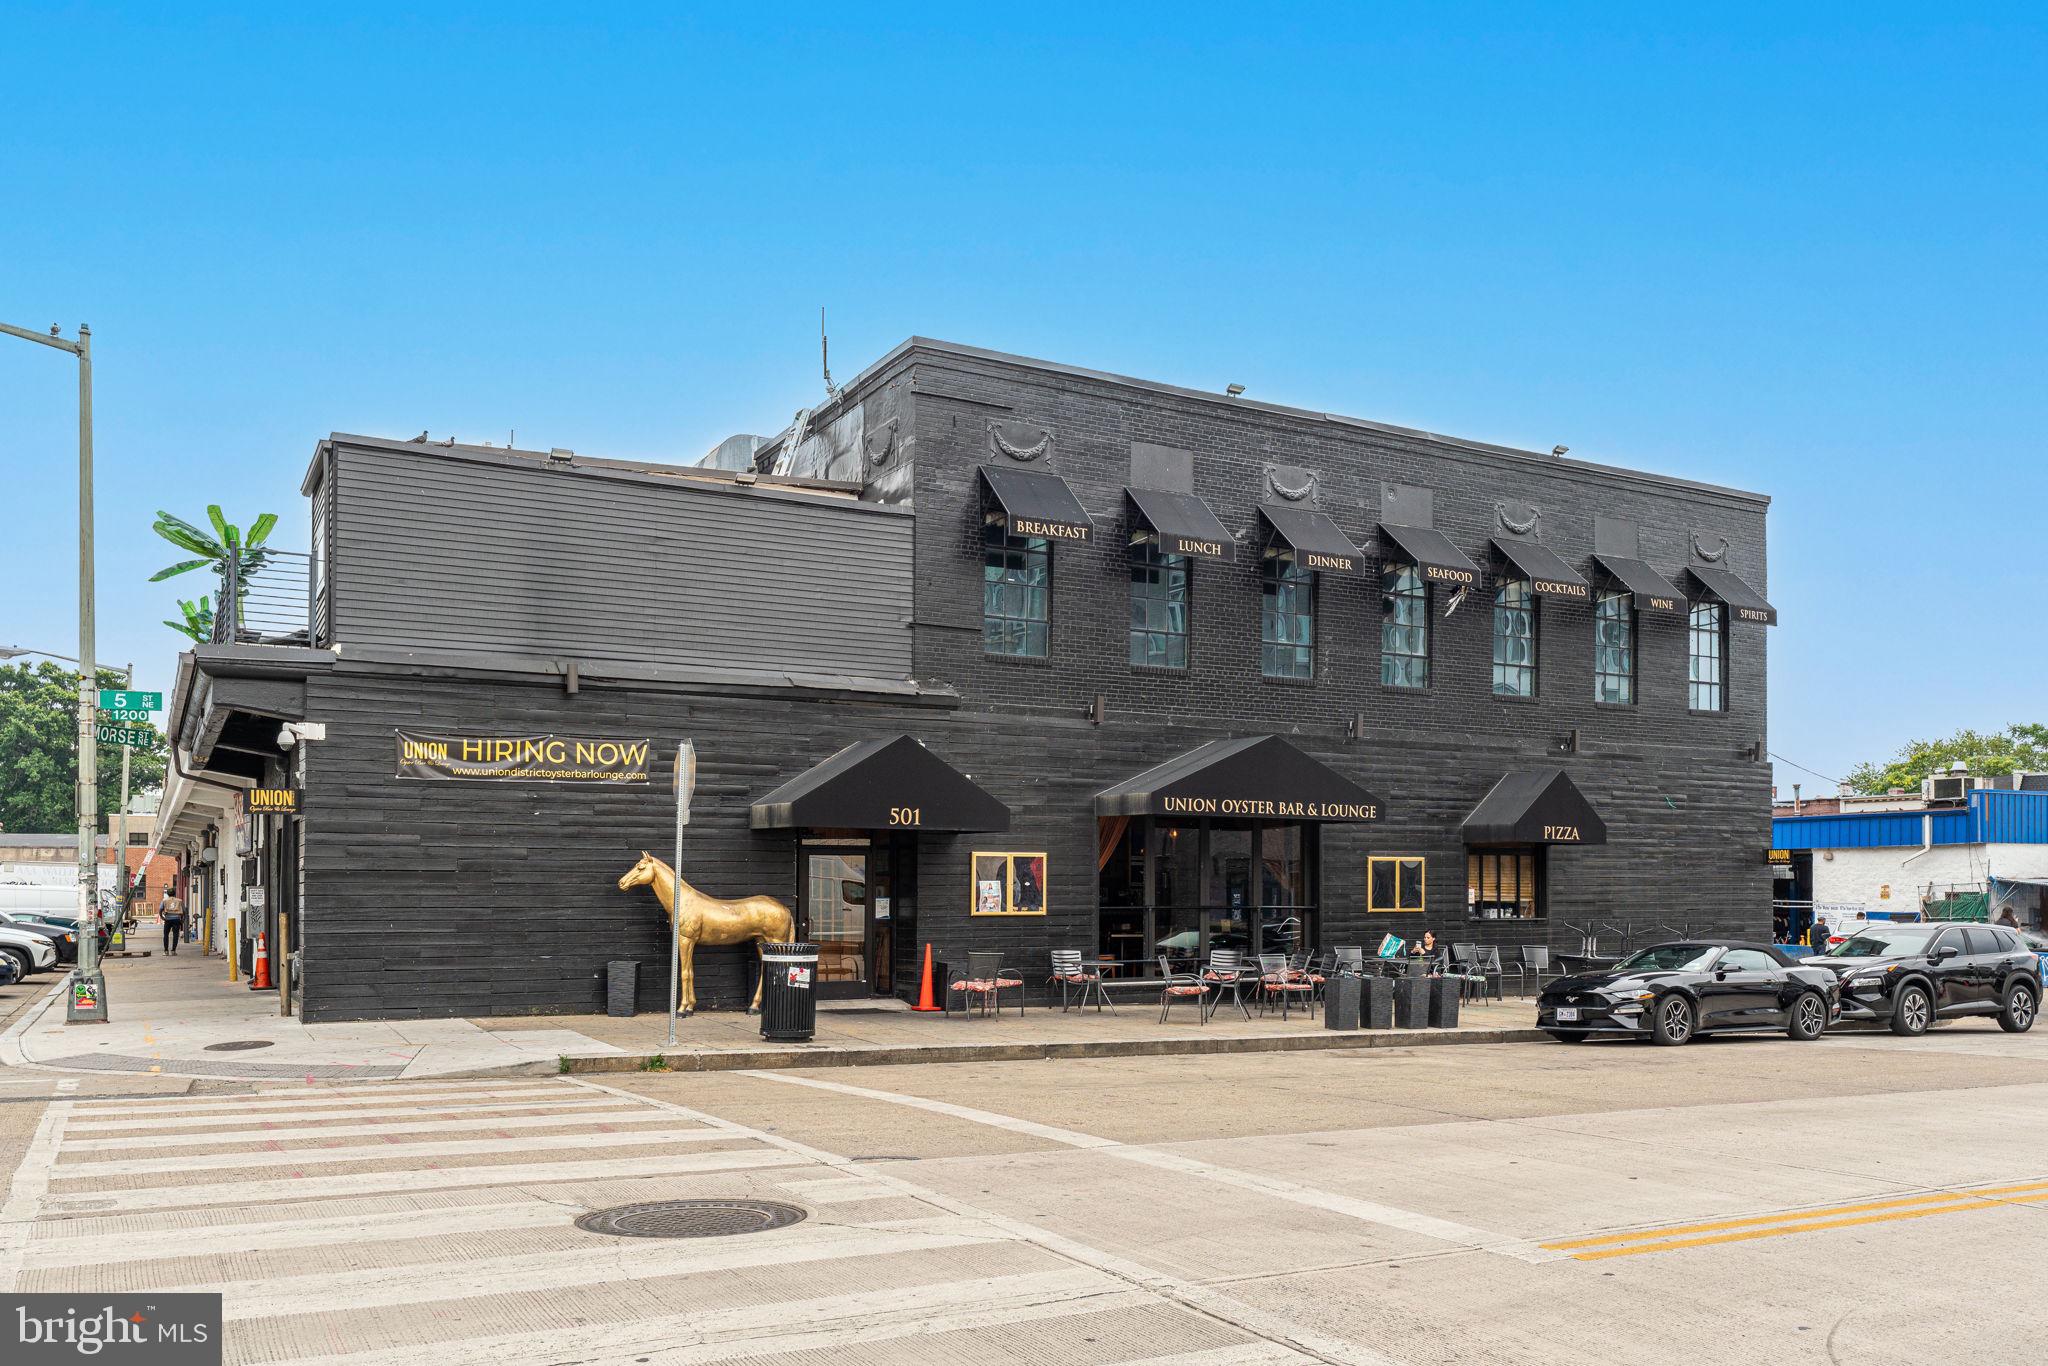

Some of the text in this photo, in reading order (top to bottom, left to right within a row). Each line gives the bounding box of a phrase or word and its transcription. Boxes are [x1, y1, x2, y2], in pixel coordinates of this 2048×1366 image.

[1016, 520, 1088, 539] BREAKFAST
[1178, 539, 1221, 555] LUNCH
[1308, 554, 1352, 570] DINNER
[1427, 567, 1473, 582] SEAFOOD
[1535, 581, 1586, 597] COCKTAILS
[1650, 598, 1674, 610] WINE
[1740, 608, 1767, 621] SPIRITS
[114, 693, 153, 708] 5 ST
[112, 710, 148, 720] 1200
[138, 738, 149, 746] NE
[404, 739, 648, 766] UNION HIRING NOW
[452, 766, 647, 781] www.uniondistrictoysterbarlounge.com
[250, 789, 293, 806] UNION
[1164, 796, 1377, 819] UNION OYSTER BAR & LOUNGE
[889, 807, 921, 826] 501
[1543, 825, 1581, 841] PIZZA
[1768, 849, 1789, 860] UNION
